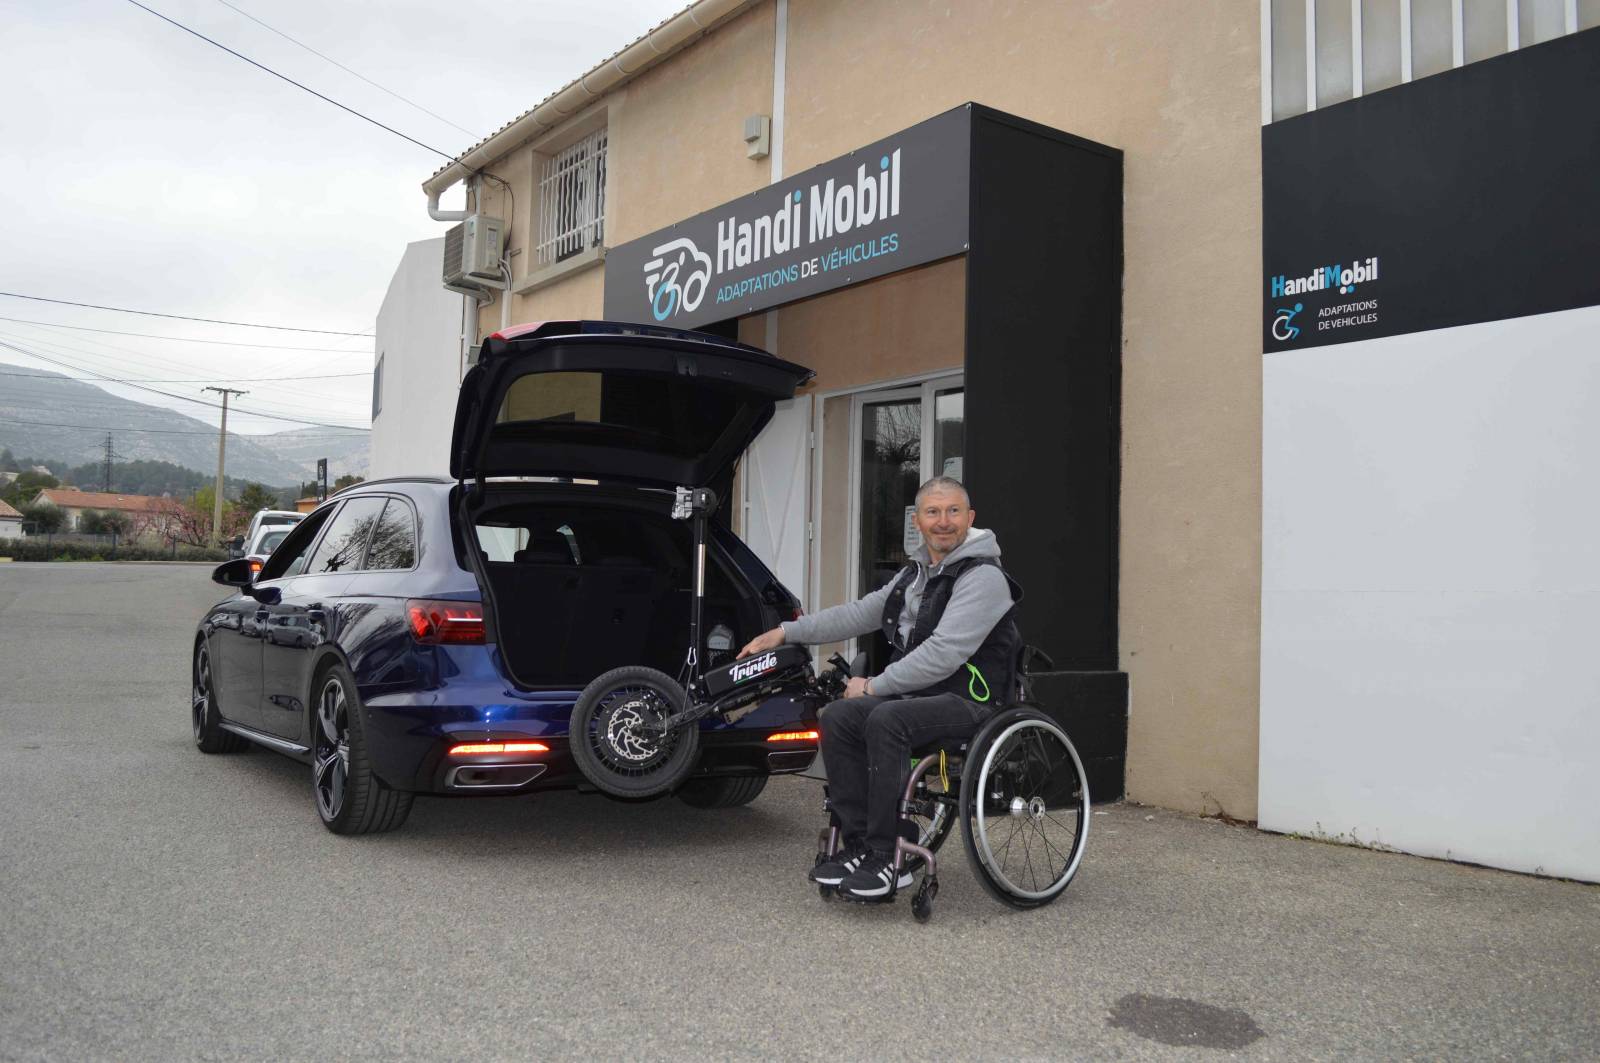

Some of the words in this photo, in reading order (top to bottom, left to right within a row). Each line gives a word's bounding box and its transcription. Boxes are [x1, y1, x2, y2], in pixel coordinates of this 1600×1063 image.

[716, 190, 802, 275] Handi
[808, 147, 901, 243] Mobil
[716, 265, 799, 304] ADAPTATIONS
[801, 257, 818, 279] DE
[820, 233, 899, 273] VÉHICULES
[1271, 257, 1378, 298] HandiMobil
[1318, 299, 1378, 317] ADAPTATIONS
[1318, 320, 1330, 331] DE
[1331, 313, 1378, 328] VEHICULES
[729, 652, 778, 682] Triride
